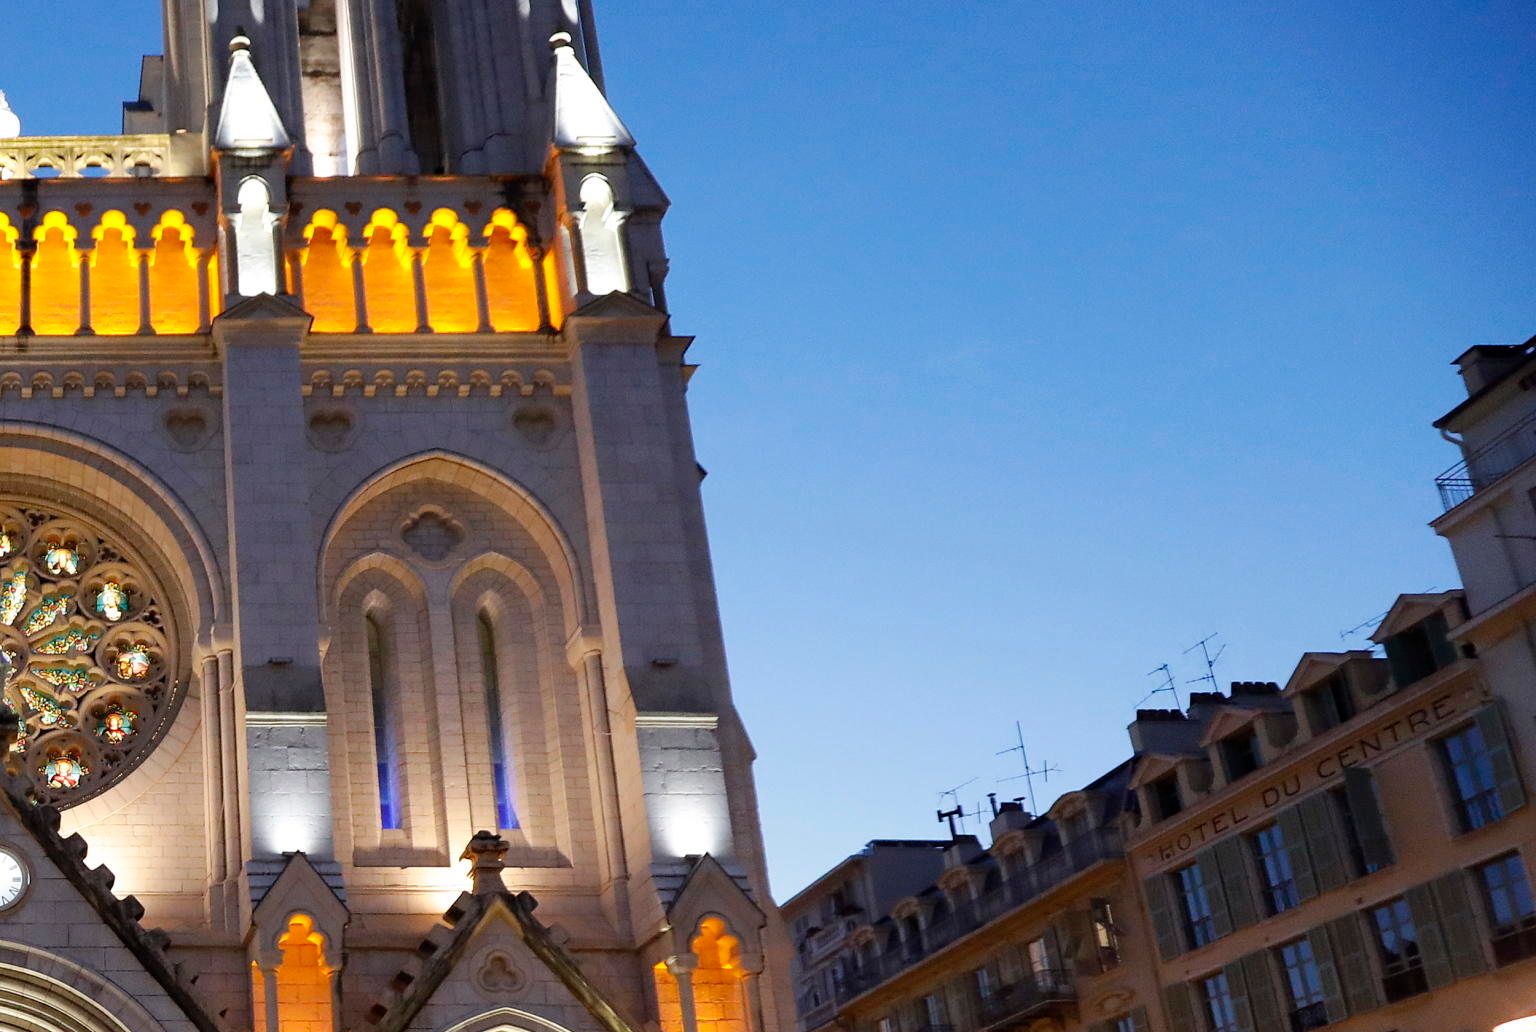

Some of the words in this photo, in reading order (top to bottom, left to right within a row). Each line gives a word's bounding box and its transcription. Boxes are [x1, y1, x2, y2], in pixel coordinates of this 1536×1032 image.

[1159, 807, 1249, 861] HOTEL
[1263, 774, 1301, 808] DU
[1316, 695, 1456, 778] CENTRE
